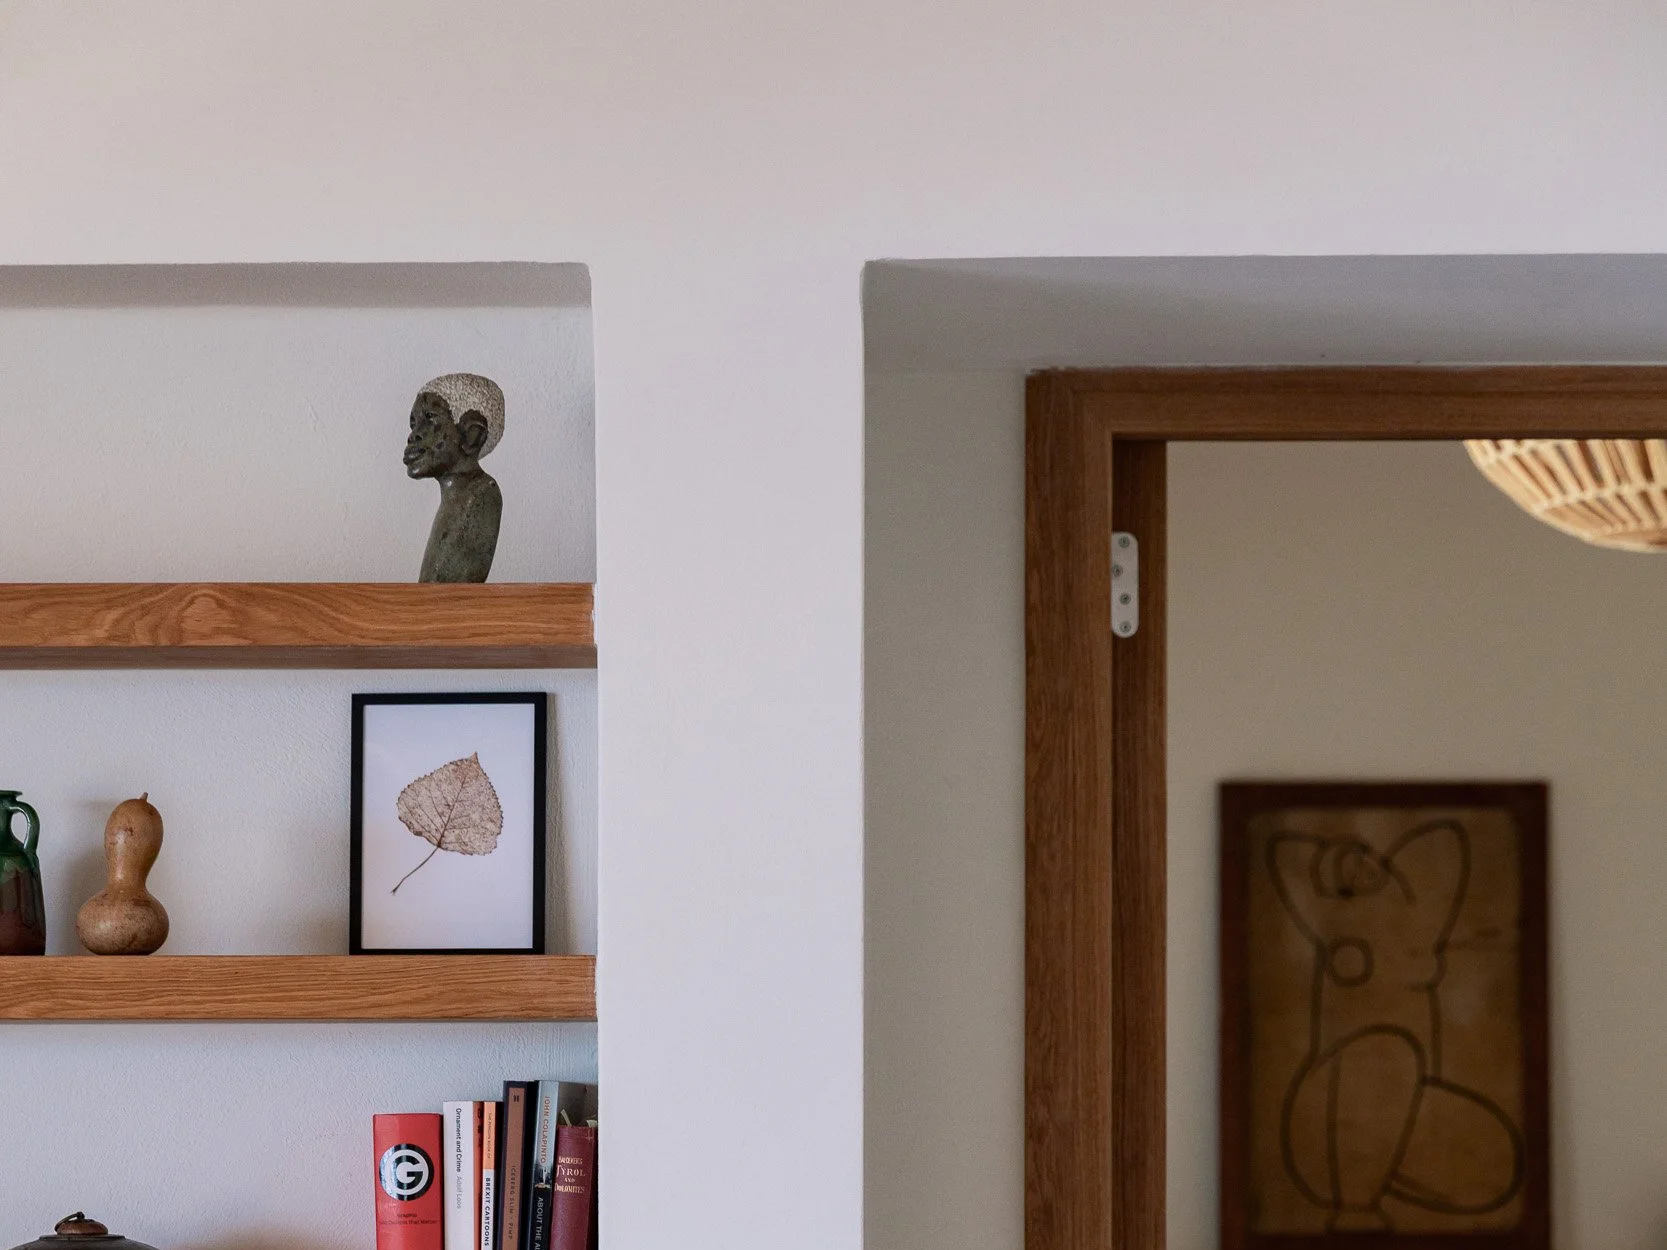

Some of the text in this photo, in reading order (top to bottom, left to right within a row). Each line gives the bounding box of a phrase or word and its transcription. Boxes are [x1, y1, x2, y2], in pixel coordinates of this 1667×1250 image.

[540, 1096, 551, 1164] JOHN COLAPINTO
[556, 1164, 586, 1178] TYROL
[536, 1196, 544, 1225] ABOUT
